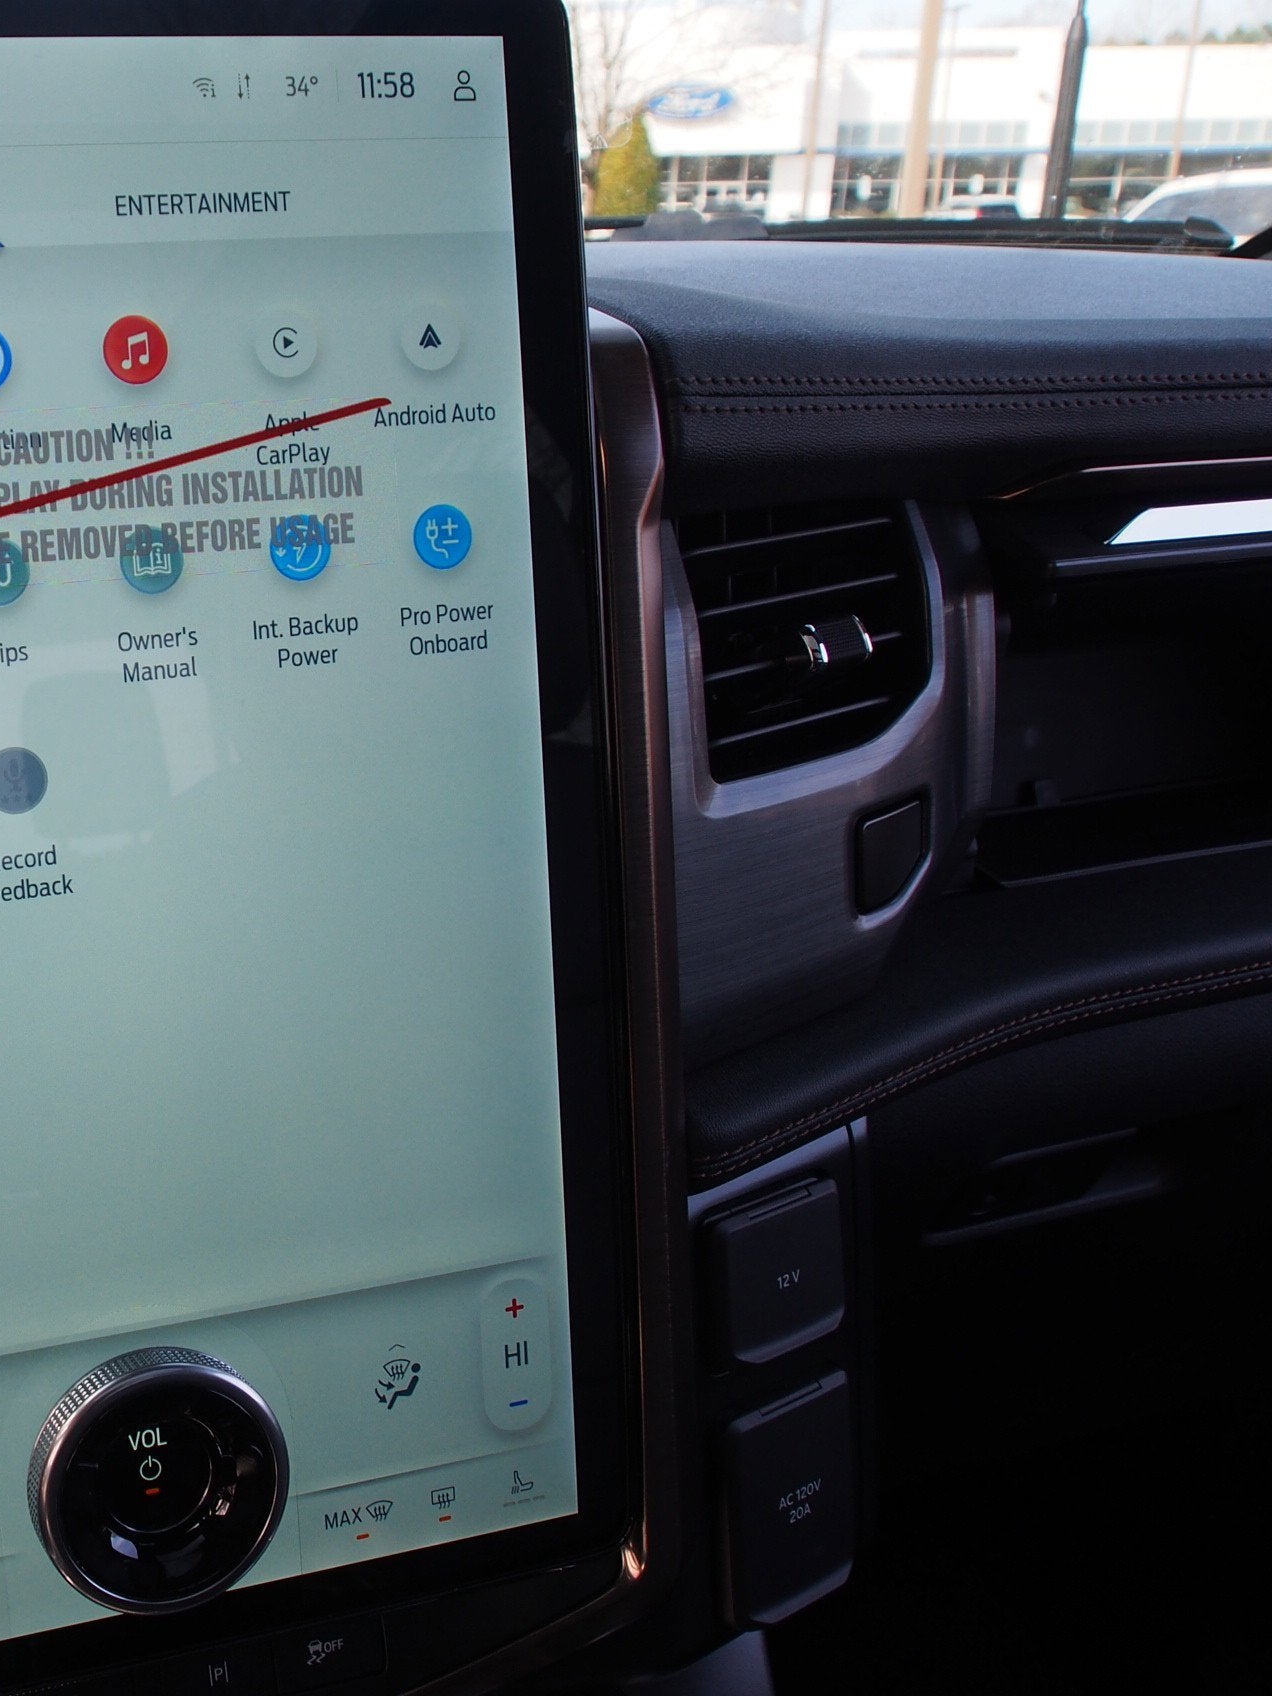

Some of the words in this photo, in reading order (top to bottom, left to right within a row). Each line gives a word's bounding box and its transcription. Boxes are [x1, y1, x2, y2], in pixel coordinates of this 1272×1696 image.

[356, 71, 416, 100] 11:58
[114, 190, 291, 217] ENTERTAINMENT
[373, 405, 448, 429] Android
[451, 403, 497, 424] Auto
[110, 419, 173, 444] Media
[255, 442, 331, 467] CarPlay
[70, 473, 174, 512] DURING
[181, 464, 364, 506] INSTALLATION
[20, 523, 154, 566] REMOVED
[160, 517, 262, 554] BEFORE
[269, 512, 356, 548] USAGE
[252, 619, 284, 641] Int.
[288, 613, 359, 639] Backup
[399, 606, 431, 628] Pro
[436, 602, 494, 625] Power
[117, 627, 199, 653] Owner's
[409, 630, 488, 657] Onboard
[122, 656, 197, 684] Manual
[277, 645, 338, 669] Power
[777, 1273, 790, 1289] 12
[791, 1268, 800, 1283] V
[504, 1339, 529, 1369] HI
[128, 1427, 168, 1449] VOL
[778, 1493, 794, 1510] AC
[795, 1478, 821, 1501] 120V
[324, 1506, 363, 1531] MAX
[789, 1503, 812, 1524] 20A
[323, 1638, 344, 1653] OFF
